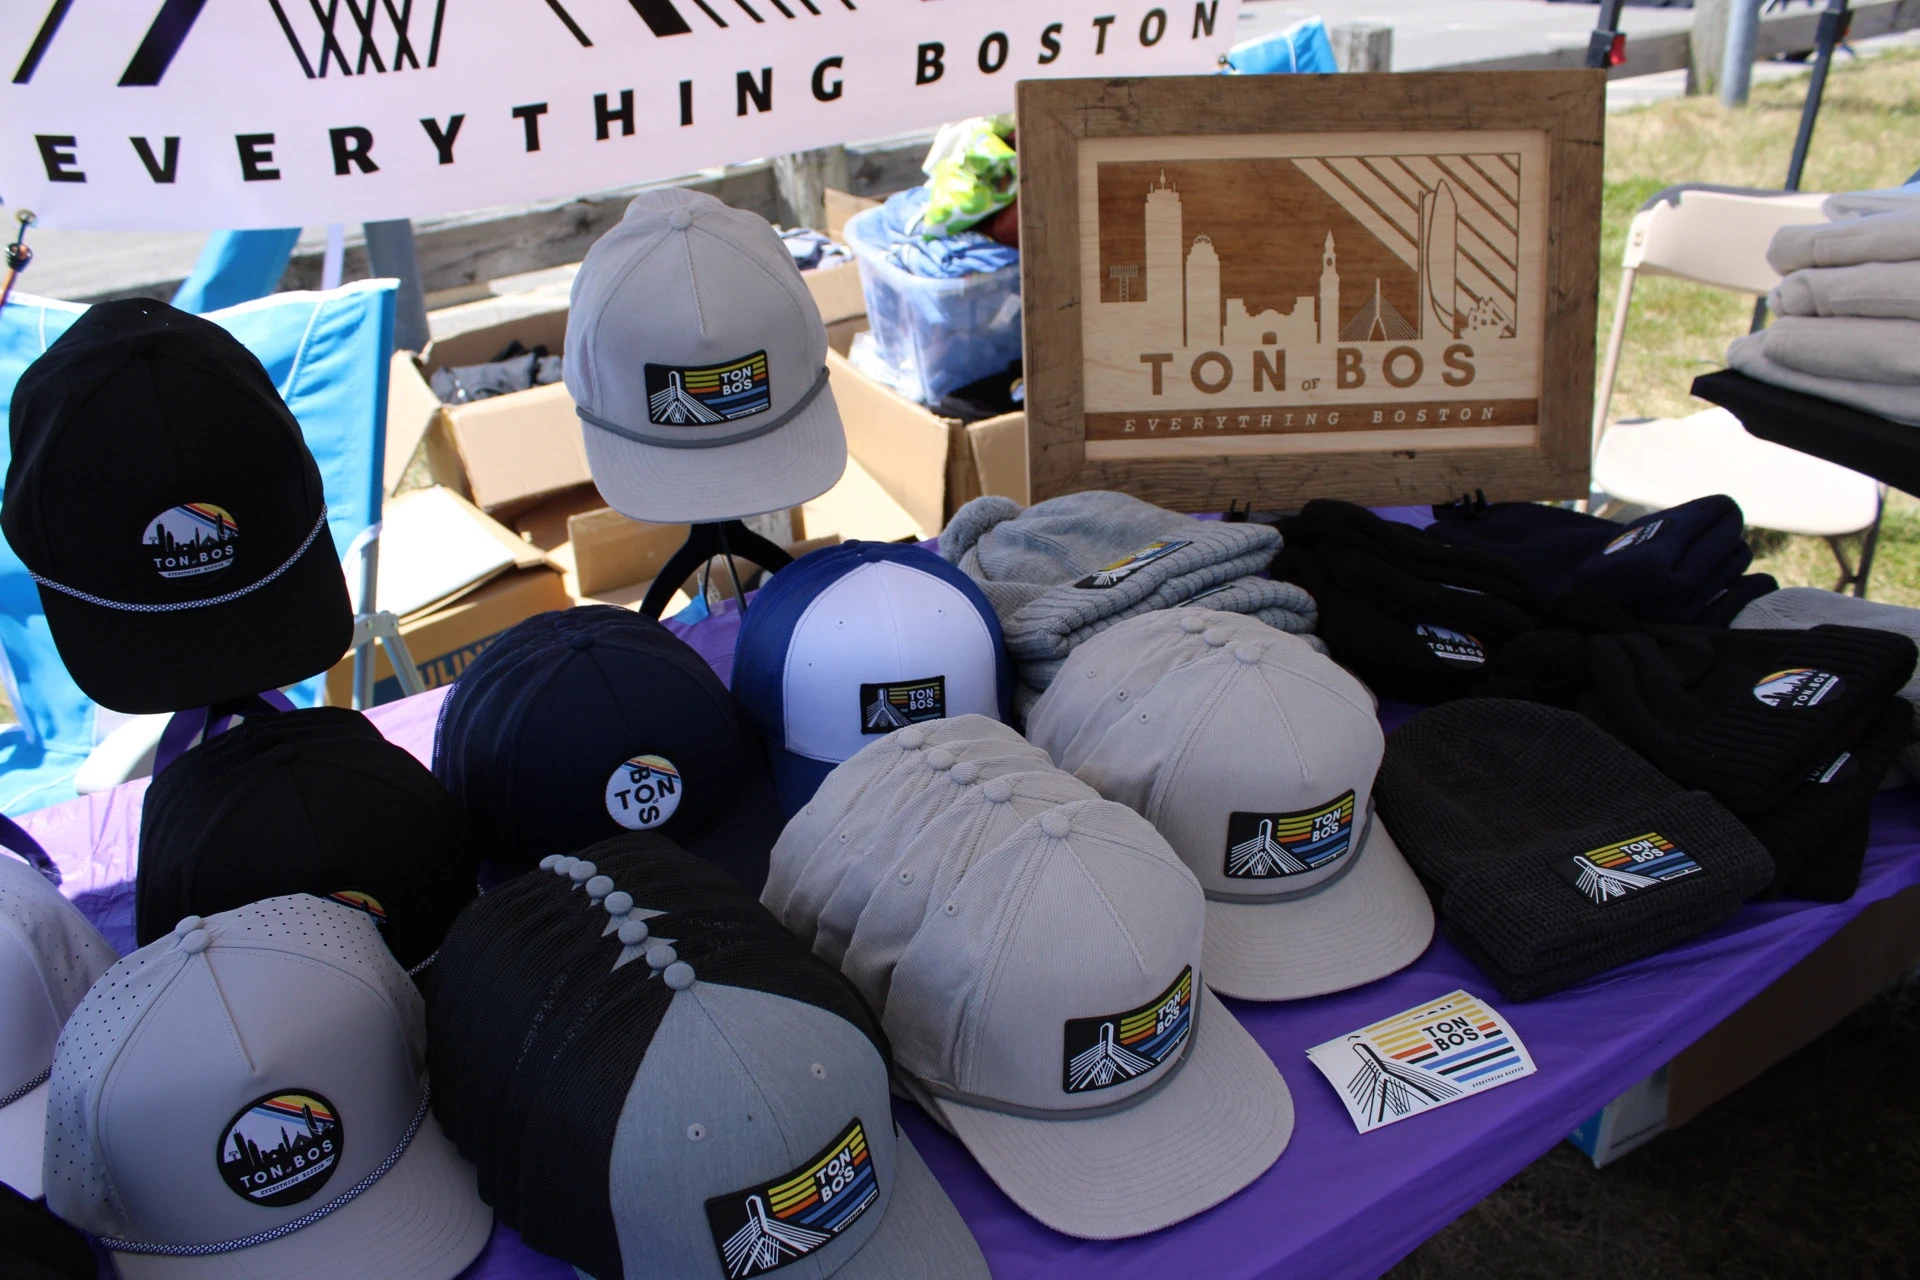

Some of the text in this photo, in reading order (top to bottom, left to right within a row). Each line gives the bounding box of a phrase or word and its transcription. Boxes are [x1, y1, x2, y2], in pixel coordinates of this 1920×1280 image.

[34, 0, 1219, 184] EVERYTHING BOSTON
[721, 366, 752, 383] TON
[1140, 343, 1476, 396] TON OF BOS
[722, 379, 753, 396] BOS
[1124, 406, 1497, 433] EVERYTHING BOSTON
[153, 545, 234, 568] TON BOS
[909, 688, 934, 700] TON
[910, 698, 934, 710] BOS
[614, 775, 676, 810] TON
[1312, 821, 1339, 842] BOS
[1314, 808, 1341, 829] TON
[1620, 840, 1654, 854] TON
[1631, 848, 1665, 863] BOS
[1158, 990, 1181, 1020] TON
[1157, 1005, 1180, 1035] BOS
[1422, 1016, 1470, 1038] TON
[1433, 1026, 1480, 1052] BOS
[240, 1164, 284, 1188] TON
[293, 1139, 333, 1169] BOS
[816, 1148, 851, 1184] TON
[260, 1163, 325, 1196] EVERYTHING BOSTON
[821, 1166, 855, 1203] BOS
